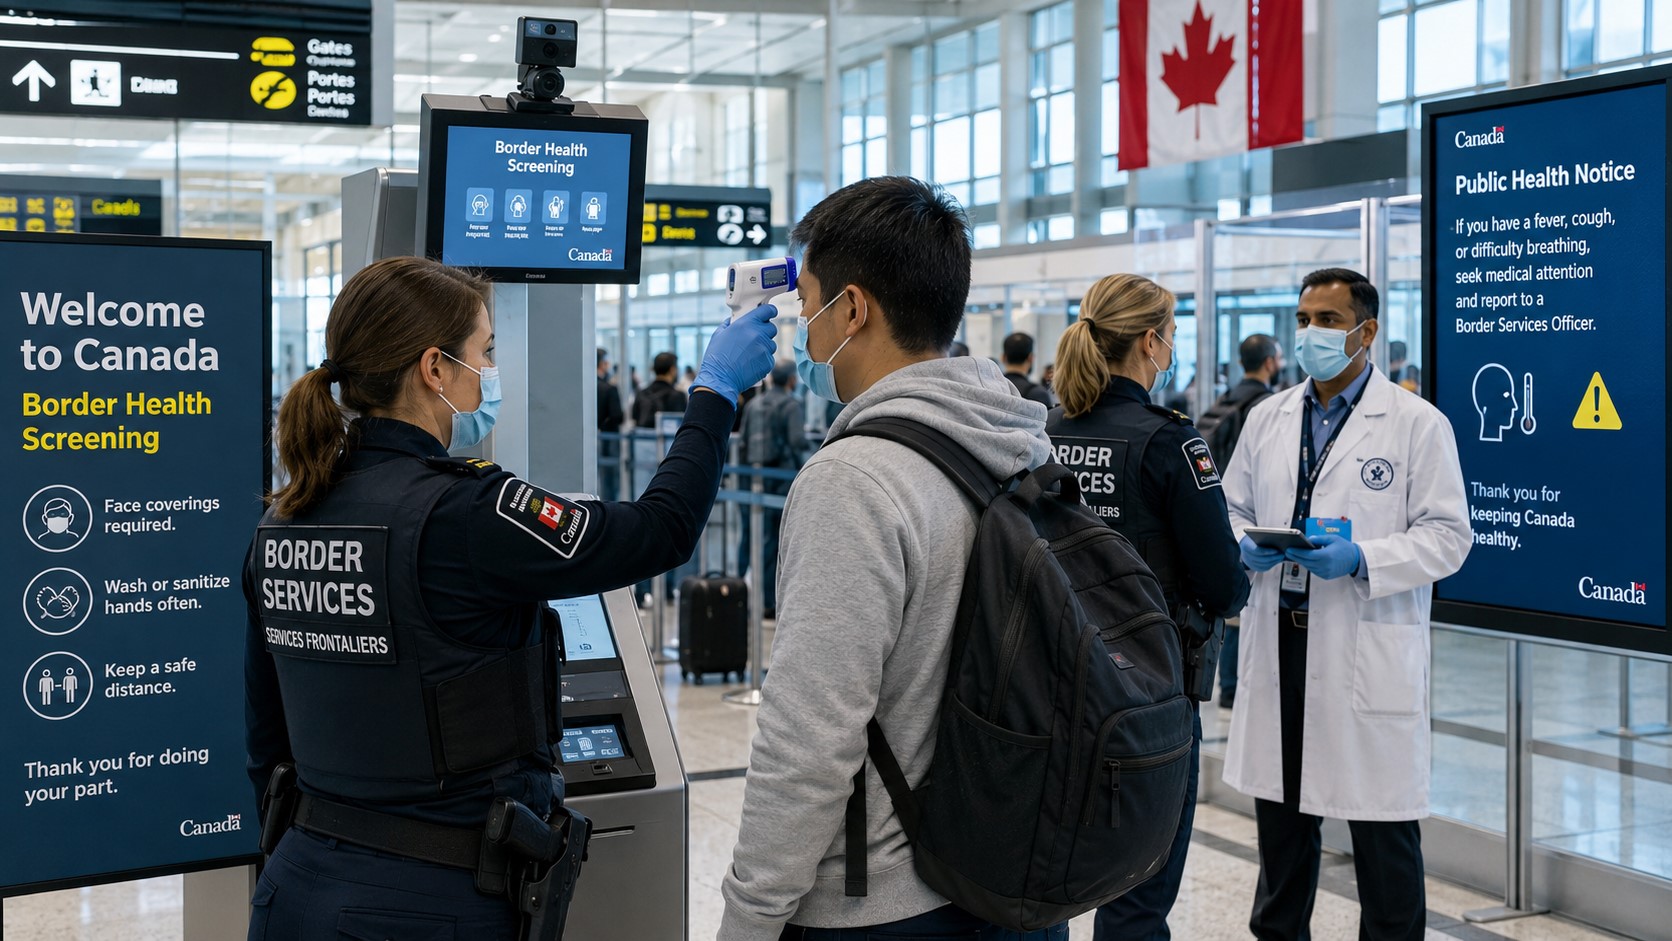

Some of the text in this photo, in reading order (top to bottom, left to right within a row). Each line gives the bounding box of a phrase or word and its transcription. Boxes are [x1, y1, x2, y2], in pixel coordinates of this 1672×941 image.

[308, 39, 352, 55] Gates
[308, 70, 355, 87] Portes
[308, 88, 355, 105] Portes
[1455, 127, 1504, 148] Canada
[495, 141, 587, 156] Border Health
[508, 159, 574, 177] Screening
[1456, 160, 1635, 195] Public Health Notice
[1456, 208, 1615, 236] If you have a fever, cough,
[569, 248, 612, 261] Canada
[1456, 237, 1590, 259] or difficulty breathing,
[1456, 263, 1593, 283] seek medical attention
[21, 292, 204, 327] Welcome
[1456, 293, 1543, 310] and report to a
[1456, 315, 1596, 333] Border Services Officer.
[21, 338, 218, 371] to Canada
[24, 392, 210, 415] Border Health
[23, 426, 159, 453] Screening
[1471, 482, 1560, 503] Thank you for
[105, 496, 219, 512] Face coverings
[105, 516, 175, 535] required.
[1471, 505, 1574, 527] keeping Canada
[1471, 529, 1521, 550] healthy.
[265, 539, 363, 572] BORDER
[105, 574, 230, 593] Wash or sanitize
[1579, 577, 1646, 605] Canada
[106, 596, 201, 614] hands often.
[263, 578, 374, 616] SERVICES
[266, 627, 388, 653] SERVICES FRONTALIERS
[106, 657, 196, 678] Keep a safe
[105, 683, 175, 697] distance.
[24, 747, 208, 778] Thank you for doing
[25, 779, 117, 806] your part.
[180, 814, 240, 836] Canada
